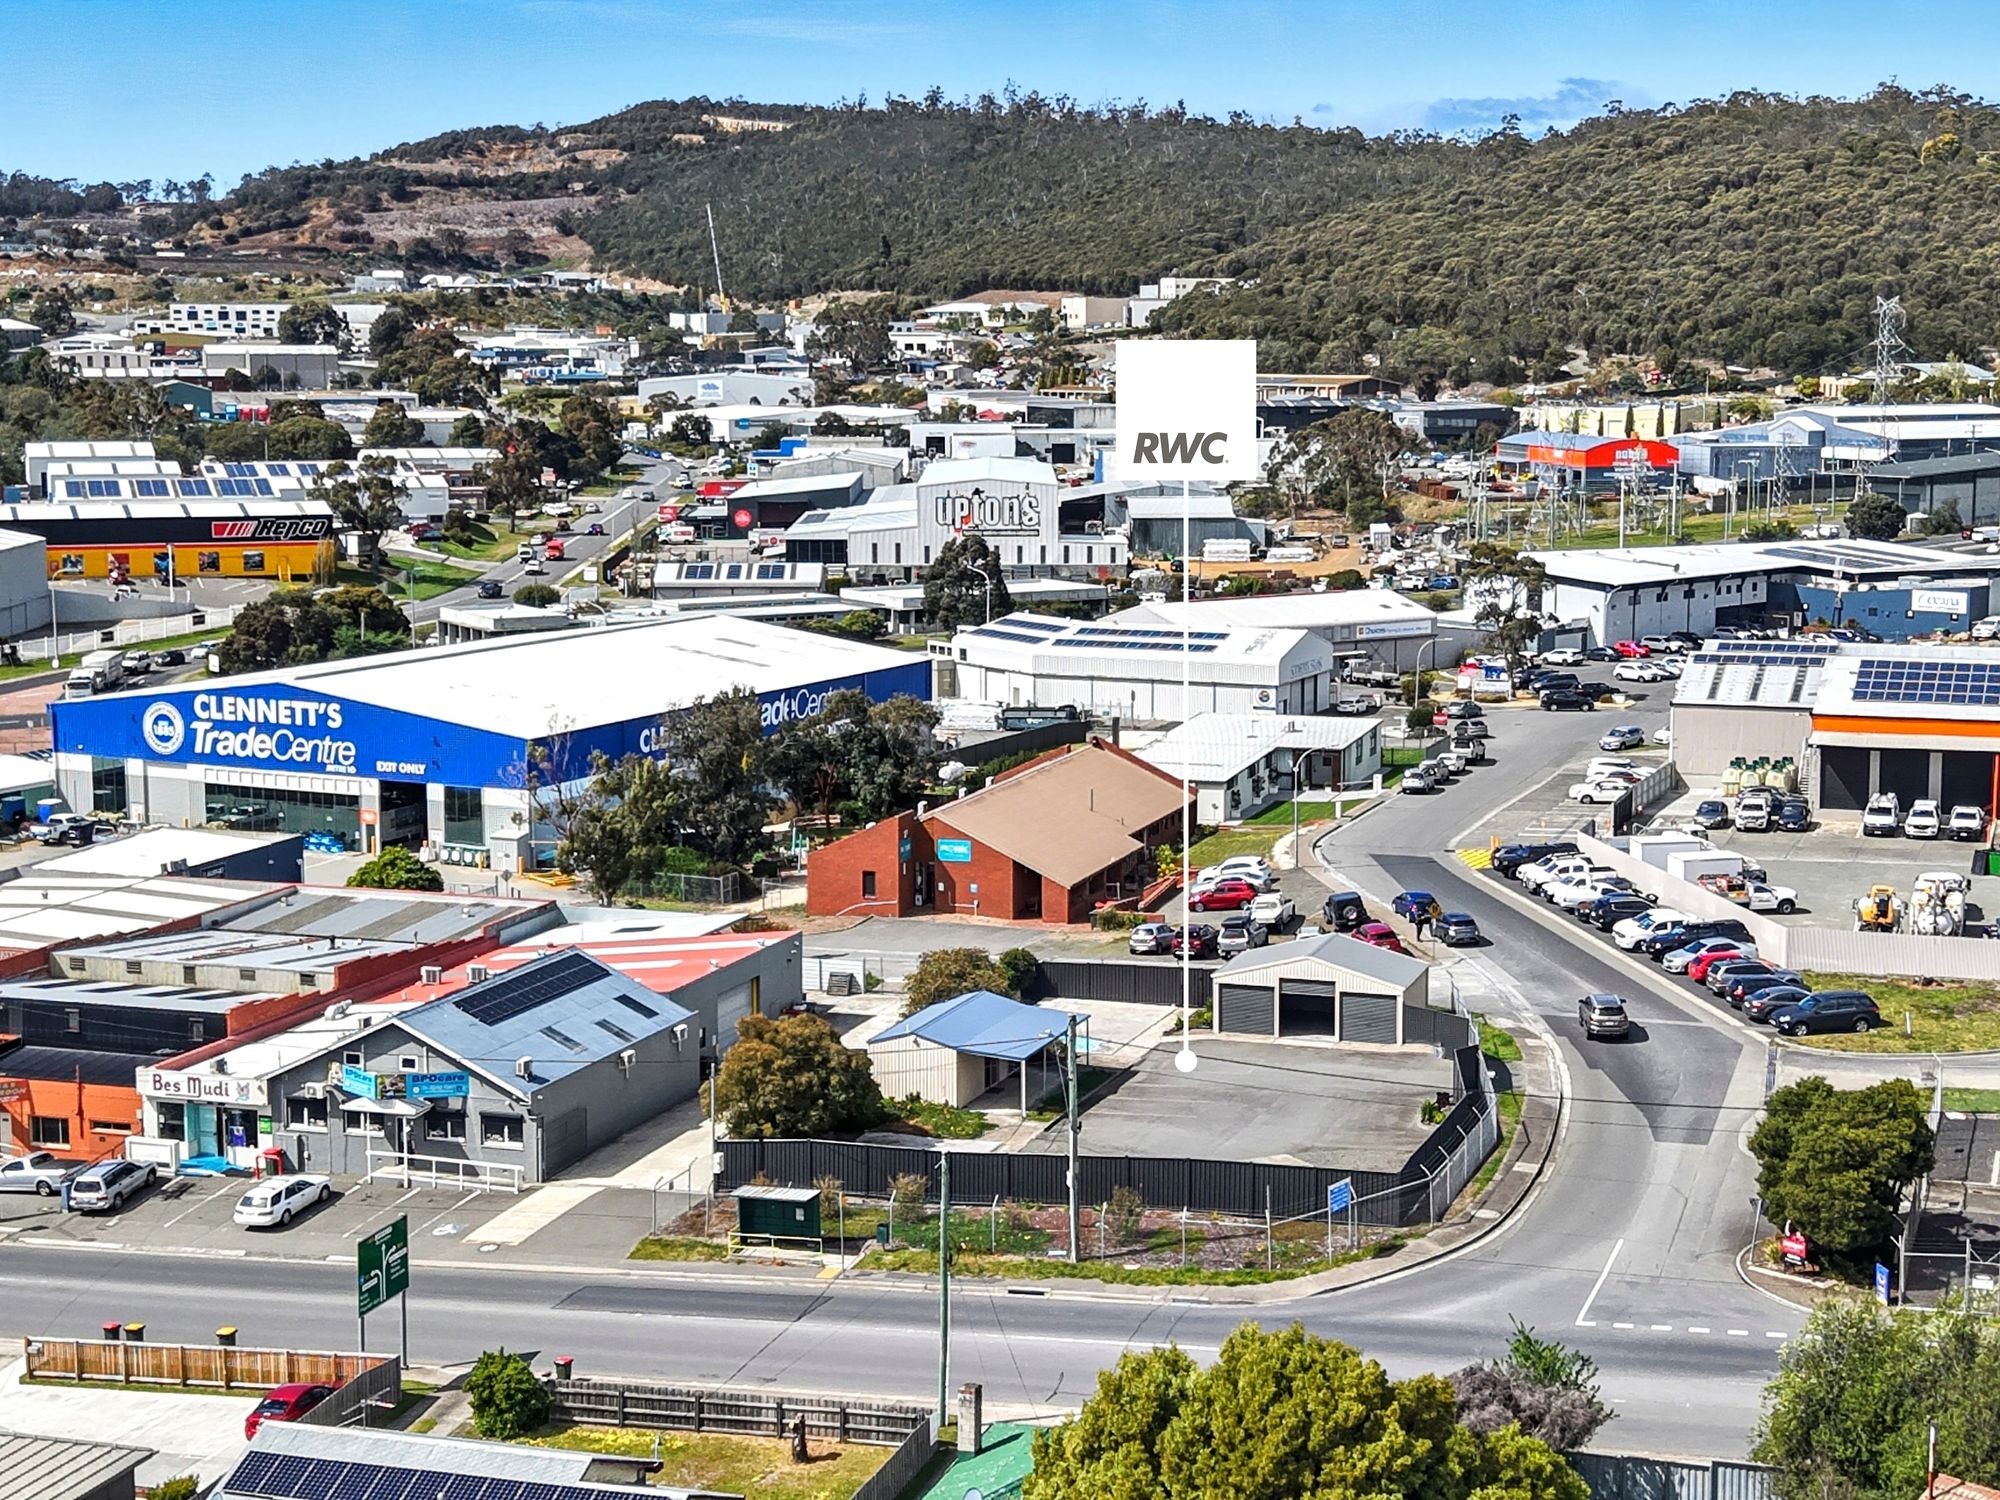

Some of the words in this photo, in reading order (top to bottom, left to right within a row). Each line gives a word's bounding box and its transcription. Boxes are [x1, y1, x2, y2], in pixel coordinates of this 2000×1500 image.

[936, 492, 1040, 531] uptons
[256, 519, 328, 540] Repco
[193, 694, 343, 729] CLENNETT'S
[190, 721, 356, 765] TradeCentre
[376, 761, 397, 773] EXIT
[398, 762, 426, 775] ONLY
[152, 1073, 181, 1092] Bes
[187, 1076, 230, 1097] Mudi
